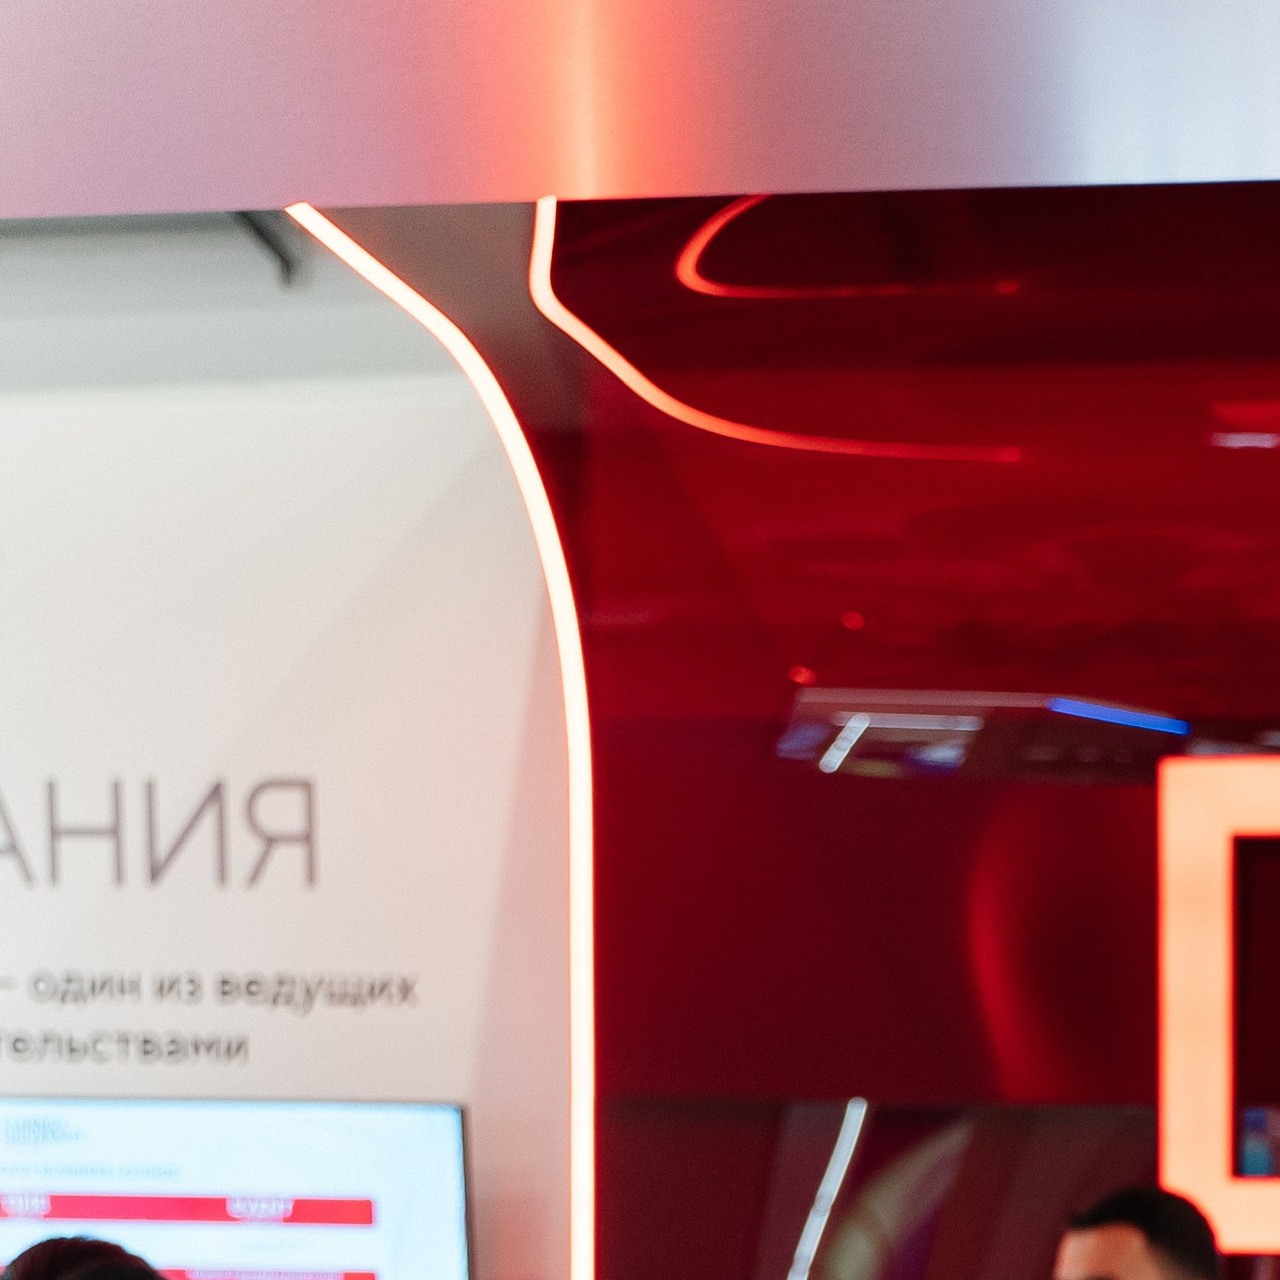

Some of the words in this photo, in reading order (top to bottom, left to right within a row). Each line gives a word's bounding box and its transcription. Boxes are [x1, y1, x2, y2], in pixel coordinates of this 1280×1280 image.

[30, 970, 142, 1005] один
[151, 970, 204, 1003] из
[216, 970, 418, 1018] ведущих
[0, 1029, 250, 1063] ельствами
